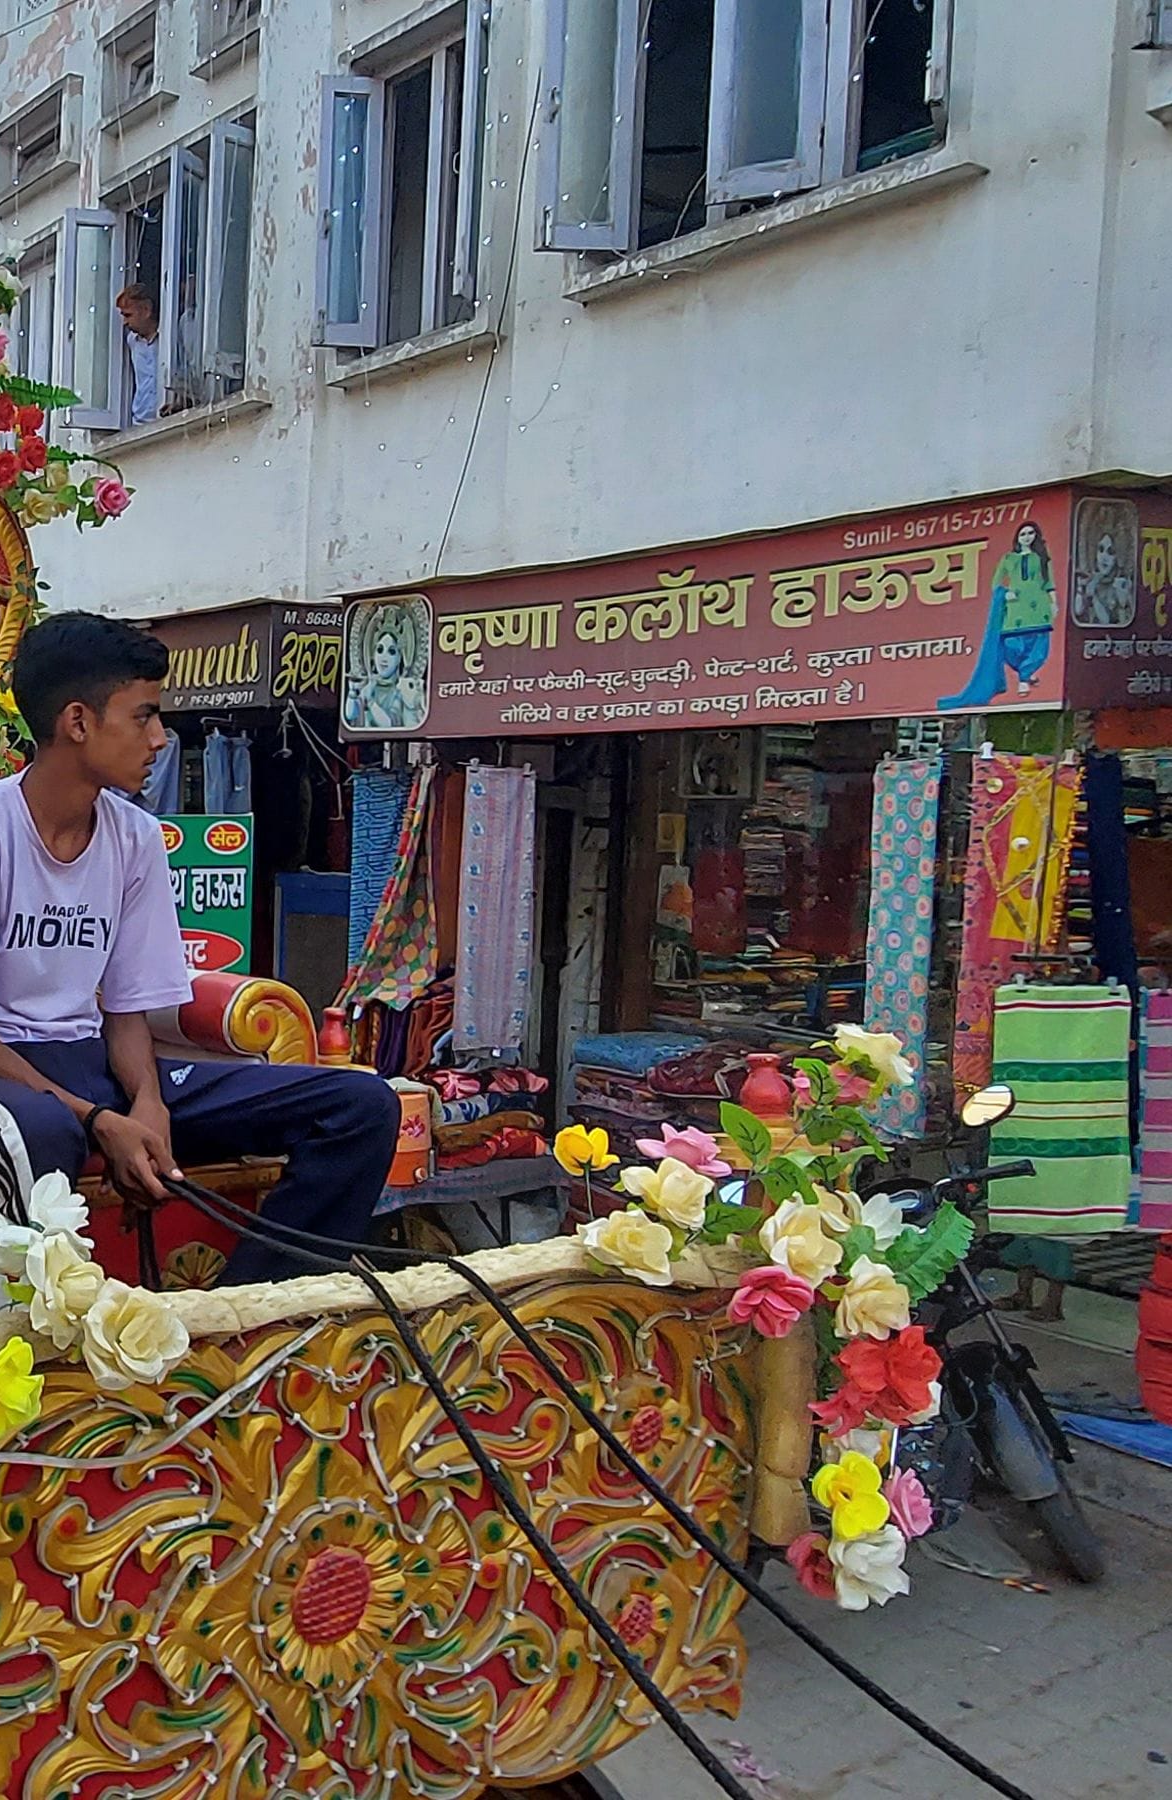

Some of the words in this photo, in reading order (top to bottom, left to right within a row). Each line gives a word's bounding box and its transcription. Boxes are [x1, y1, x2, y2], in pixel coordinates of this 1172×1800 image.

[843, 524, 899, 549] Sunil-
[903, 499, 1034, 540] 96715-73777
[1141, 527, 1172, 627] कृ
[305, 612, 343, 626] 86849
[437, 603, 563, 674] कृष्णा
[574, 569, 754, 643] कलॉथ
[770, 540, 988, 628] हाऊस
[162, 623, 262, 690] rments
[273, 631, 341, 697] अग्रव
[438, 677, 476, 698] हमारे
[479, 674, 511, 694] यहां
[513, 678, 536, 692] पर
[807, 647, 873, 677] कुरता
[879, 636, 972, 661] पजामा,
[556, 707, 568, 720] व
[574, 705, 599, 721] हर
[602, 701, 652, 721] प्रकार
[657, 699, 684, 715] का
[690, 694, 749, 719] कपड़ा
[756, 686, 828, 708] मिलता
[211, 826, 243, 848] सेल
[191, 867, 246, 912] हाऊस
[6, 913, 112, 951] MONEY
